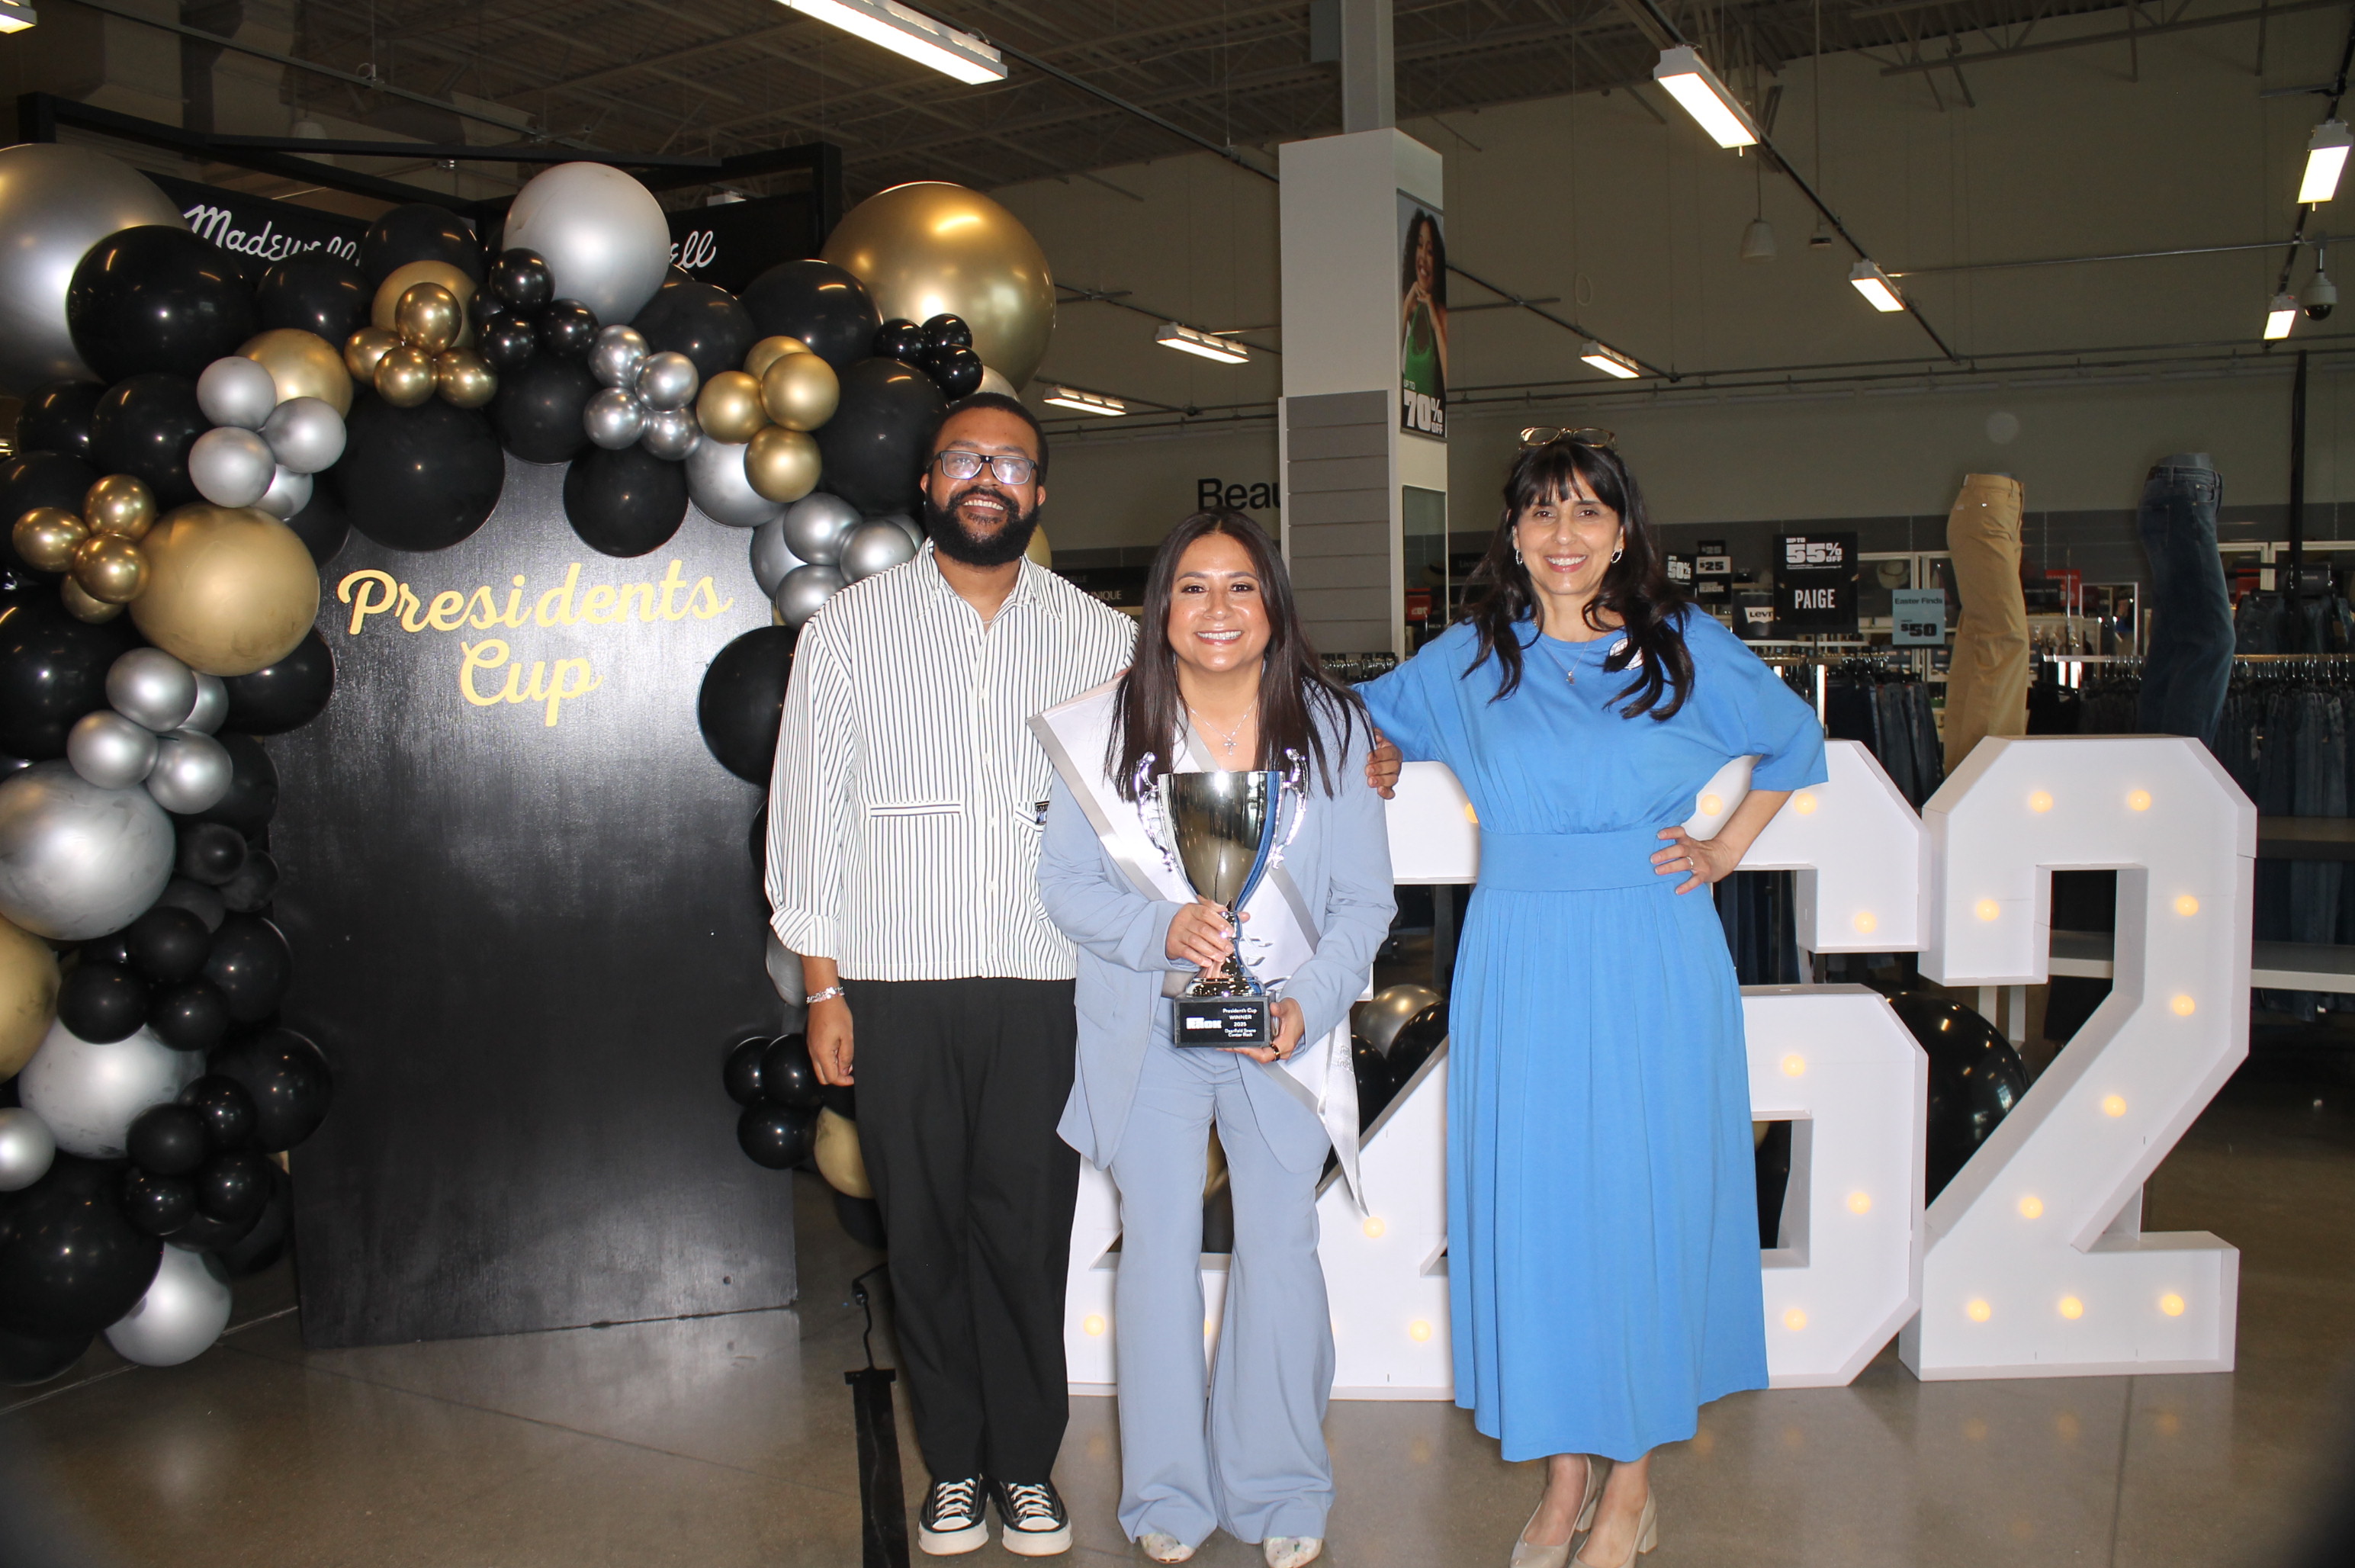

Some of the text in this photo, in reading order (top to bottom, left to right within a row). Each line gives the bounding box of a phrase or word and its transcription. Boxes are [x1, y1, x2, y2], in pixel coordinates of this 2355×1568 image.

[1403, 389, 1443, 432] 70%
[1431, 422, 1443, 435] OFF
[1786, 542, 1843, 564] 55%
[1699, 561, 1724, 571] $25
[337, 559, 734, 635] Presidents
[1794, 589, 1836, 609] PAIGE
[1900, 623, 1937, 637] $50
[460, 638, 603, 727] Cup
